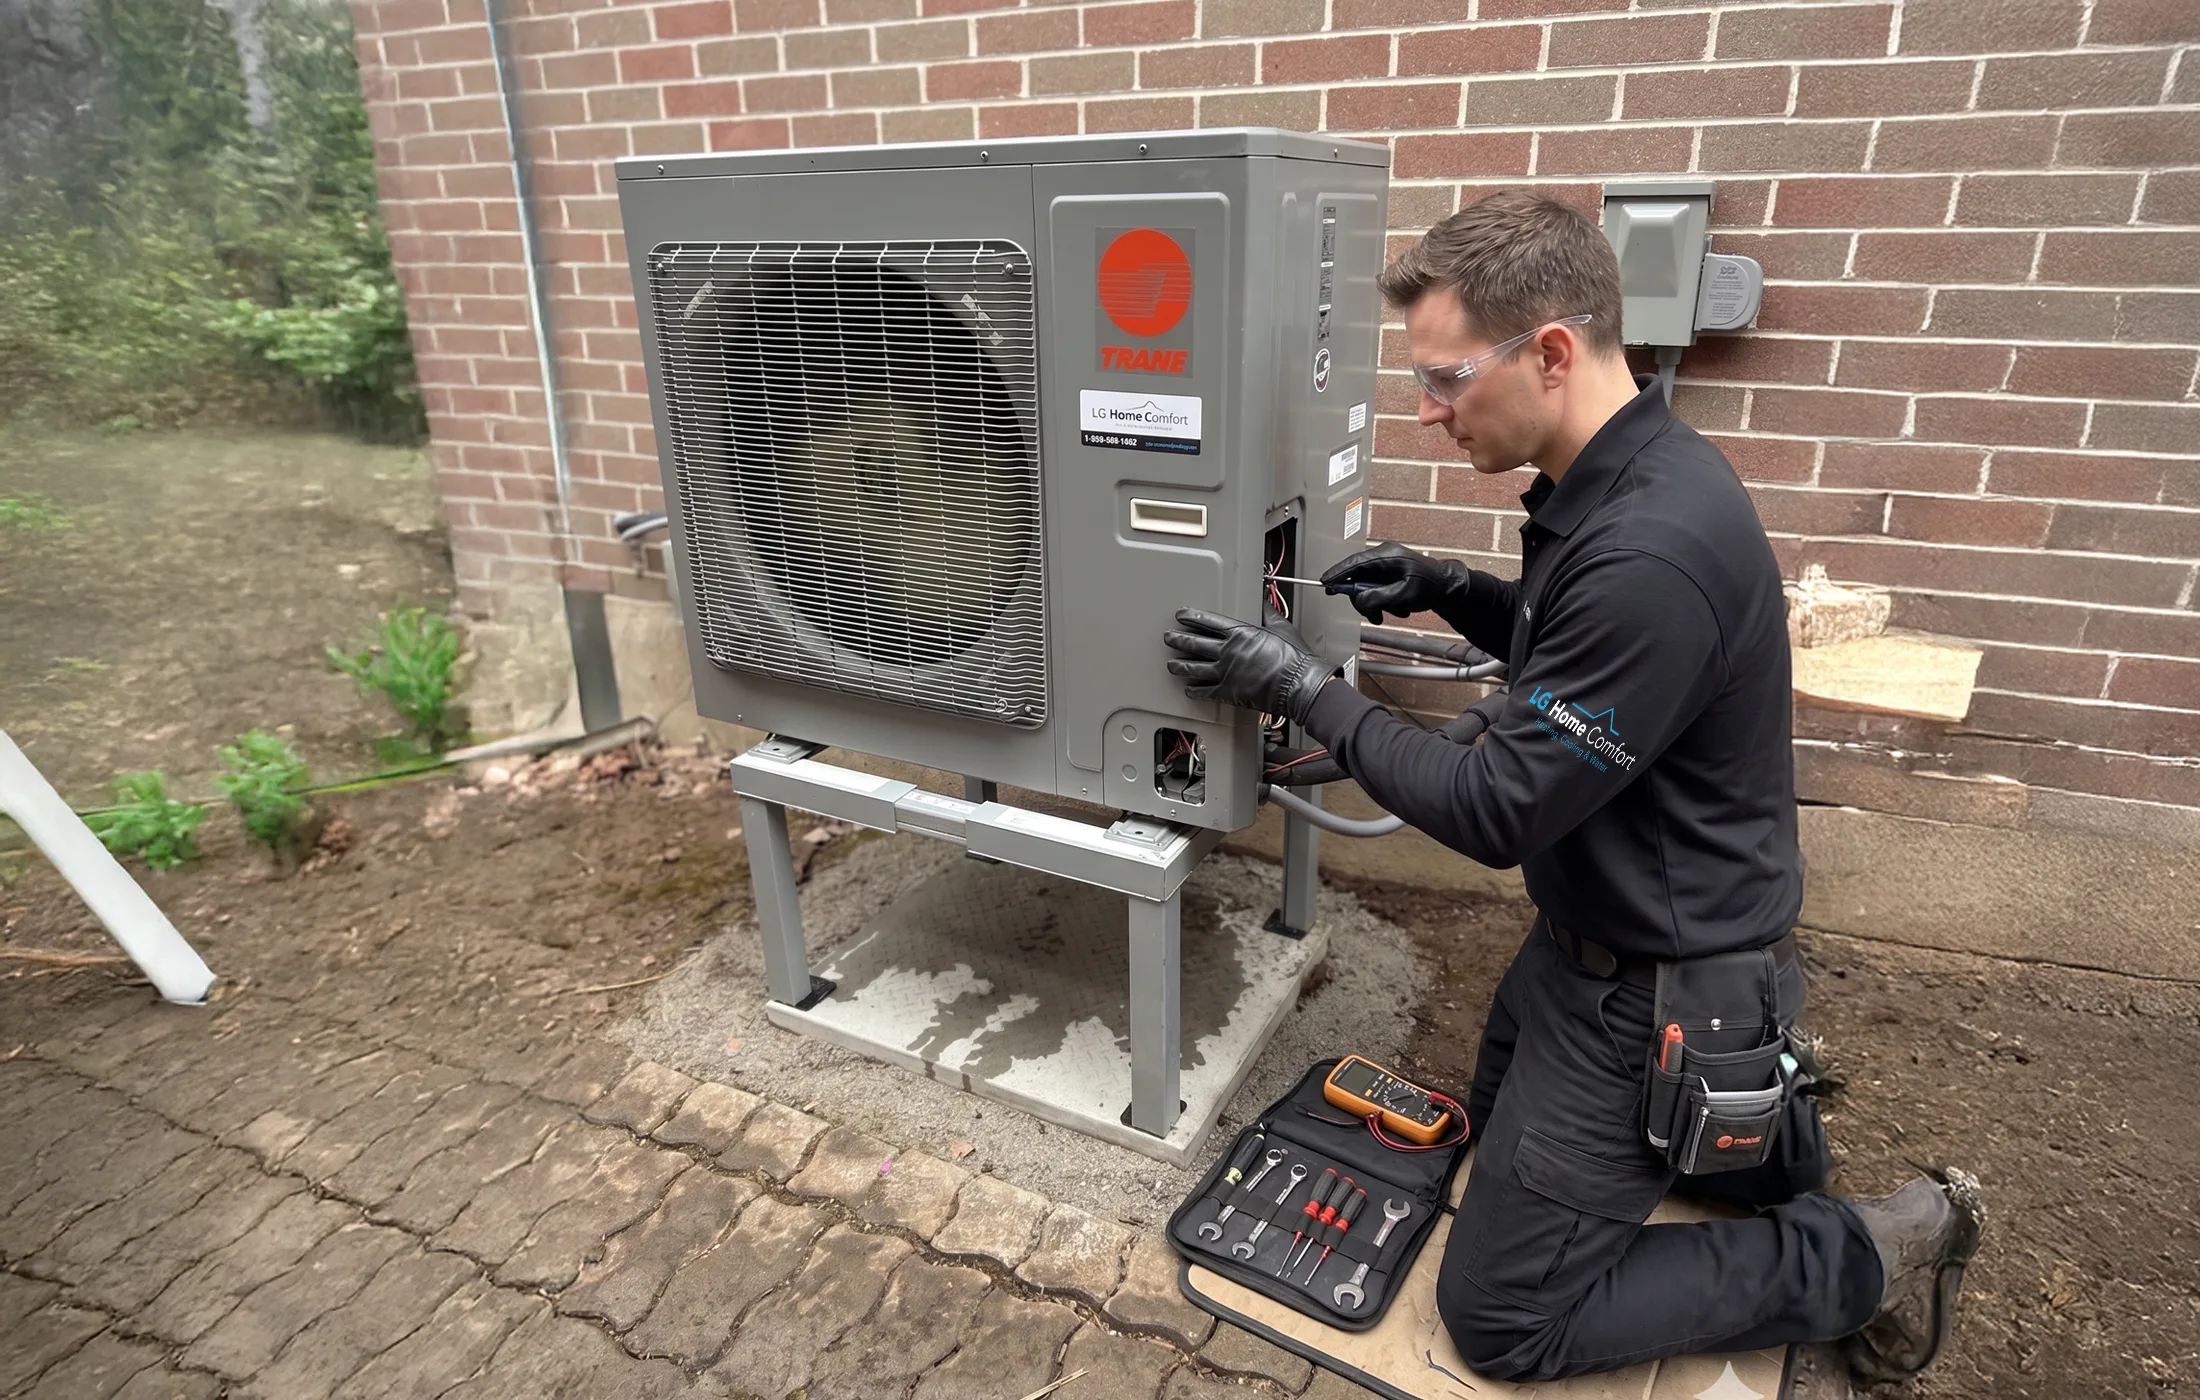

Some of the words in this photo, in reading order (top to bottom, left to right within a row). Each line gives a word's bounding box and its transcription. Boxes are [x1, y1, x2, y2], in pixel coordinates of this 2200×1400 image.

[1101, 346, 1188, 372] TRANE
[1092, 407, 1106, 418] LG
[1110, 409, 1142, 422] Home
[1145, 411, 1189, 425] Comfort
[1529, 685, 1553, 711] LG
[1548, 699, 1587, 737] Home
[1586, 726, 1636, 771] Comfort
[1560, 734, 1584, 758] Cooling
[1590, 754, 1609, 773] Water
